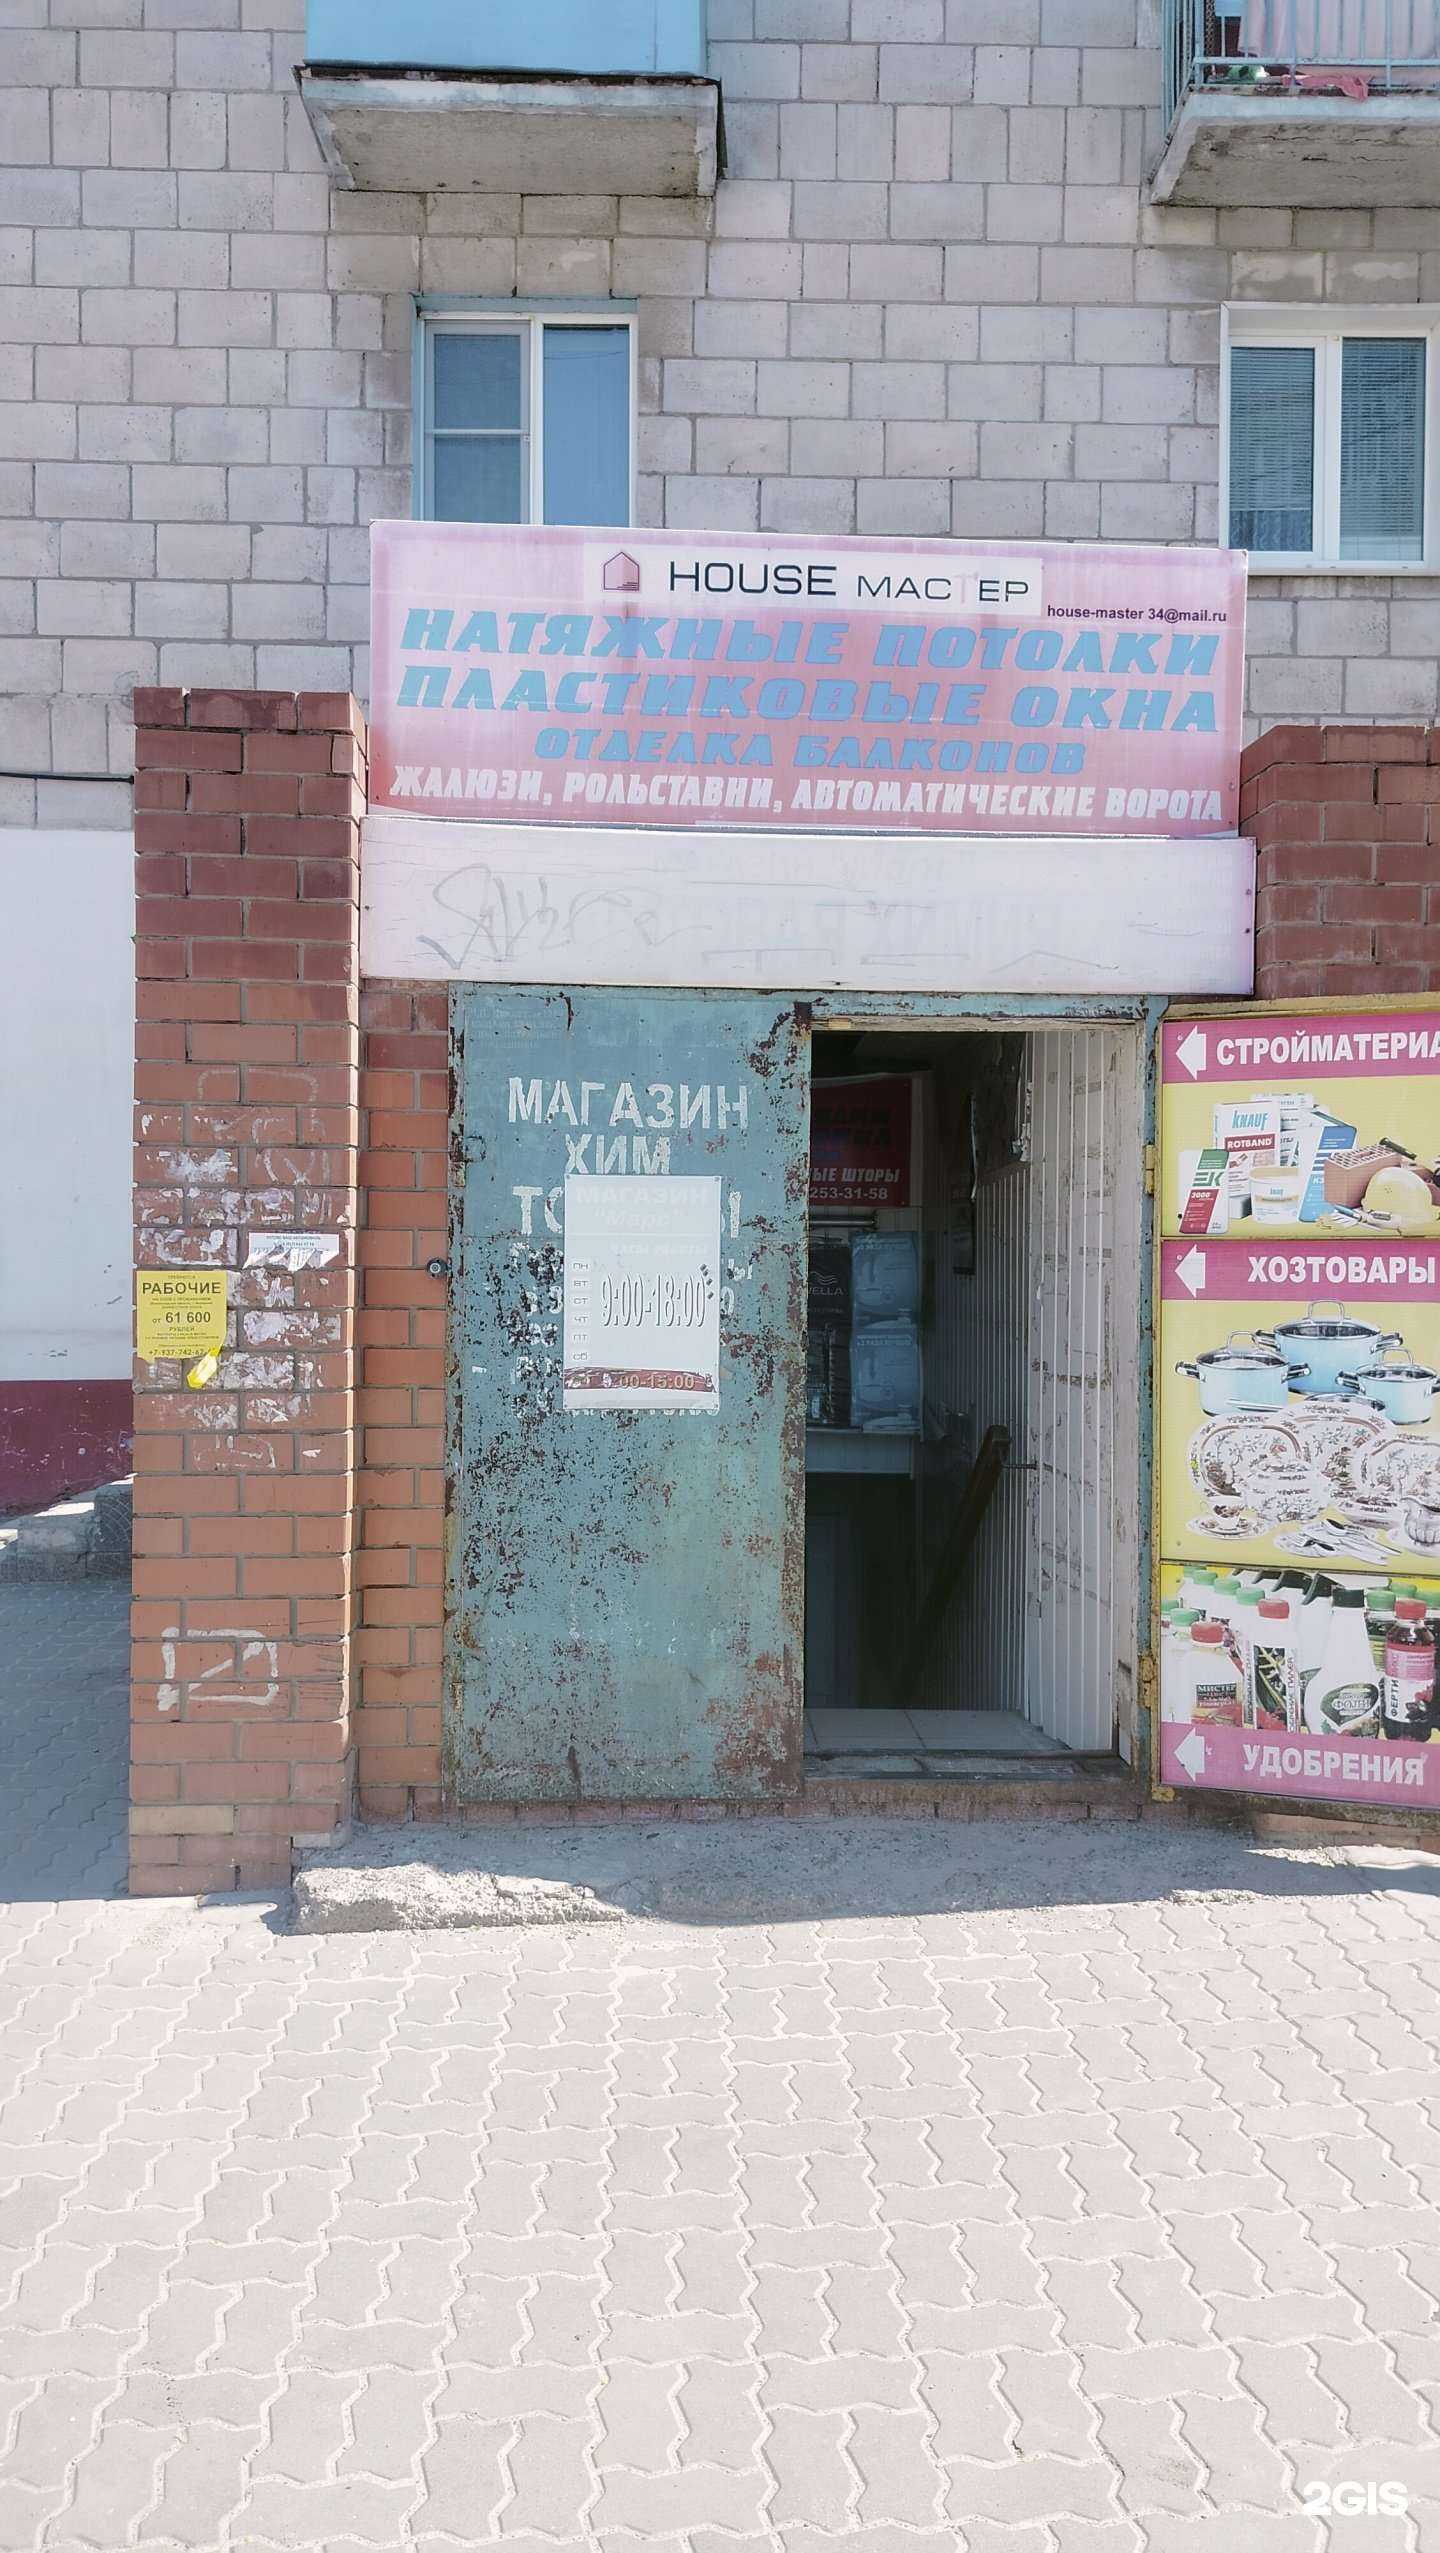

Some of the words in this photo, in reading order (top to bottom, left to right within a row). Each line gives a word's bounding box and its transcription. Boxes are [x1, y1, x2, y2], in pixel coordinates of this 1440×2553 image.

[670, 561, 837, 596] HOUSE
[1047, 605, 1144, 620] house-master
[1148, 608, 1227, 624] 34@mail.ru
[400, 608, 849, 665] НАТЯЖНЫЕ
[873, 623, 1220, 676] ПОТОЛКИ
[397, 665, 987, 726] ПЛАСТИКОВЫЕ
[1010, 686, 1219, 732] ОКНА
[535, 727, 773, 767] ОТДЕЛКА
[793, 735, 1087, 774] БАЛКОНОВ
[389, 766, 552, 806] ЖАЛЮЗИ,
[563, 771, 782, 813] РОЛЬСТАВНИ,
[791, 779, 1096, 818] АВТОМАТИЧЕСКИЕ
[1104, 788, 1222, 821] ВОРОТА
[508, 1077, 748, 1130] МАГАЗИН
[565, 1133, 671, 1175] ХИМ
[1227, 1137, 1272, 1150] ROTBAND
[810, 1186, 888, 1200] 253-31-58
[842, 1167, 900, 1183] ШТОРЫ
[142, 1282, 222, 1295] РАБОЧИЕ
[1248, 1255, 1436, 1284] ХОЗТОВАРЫ
[165, 1311, 181, 1323] 61
[187, 1311, 211, 1323] 600
[602, 1273, 706, 1328] 9:00-18:00
[1242, 1744, 1424, 1786] УДОБРЕНИЯ
